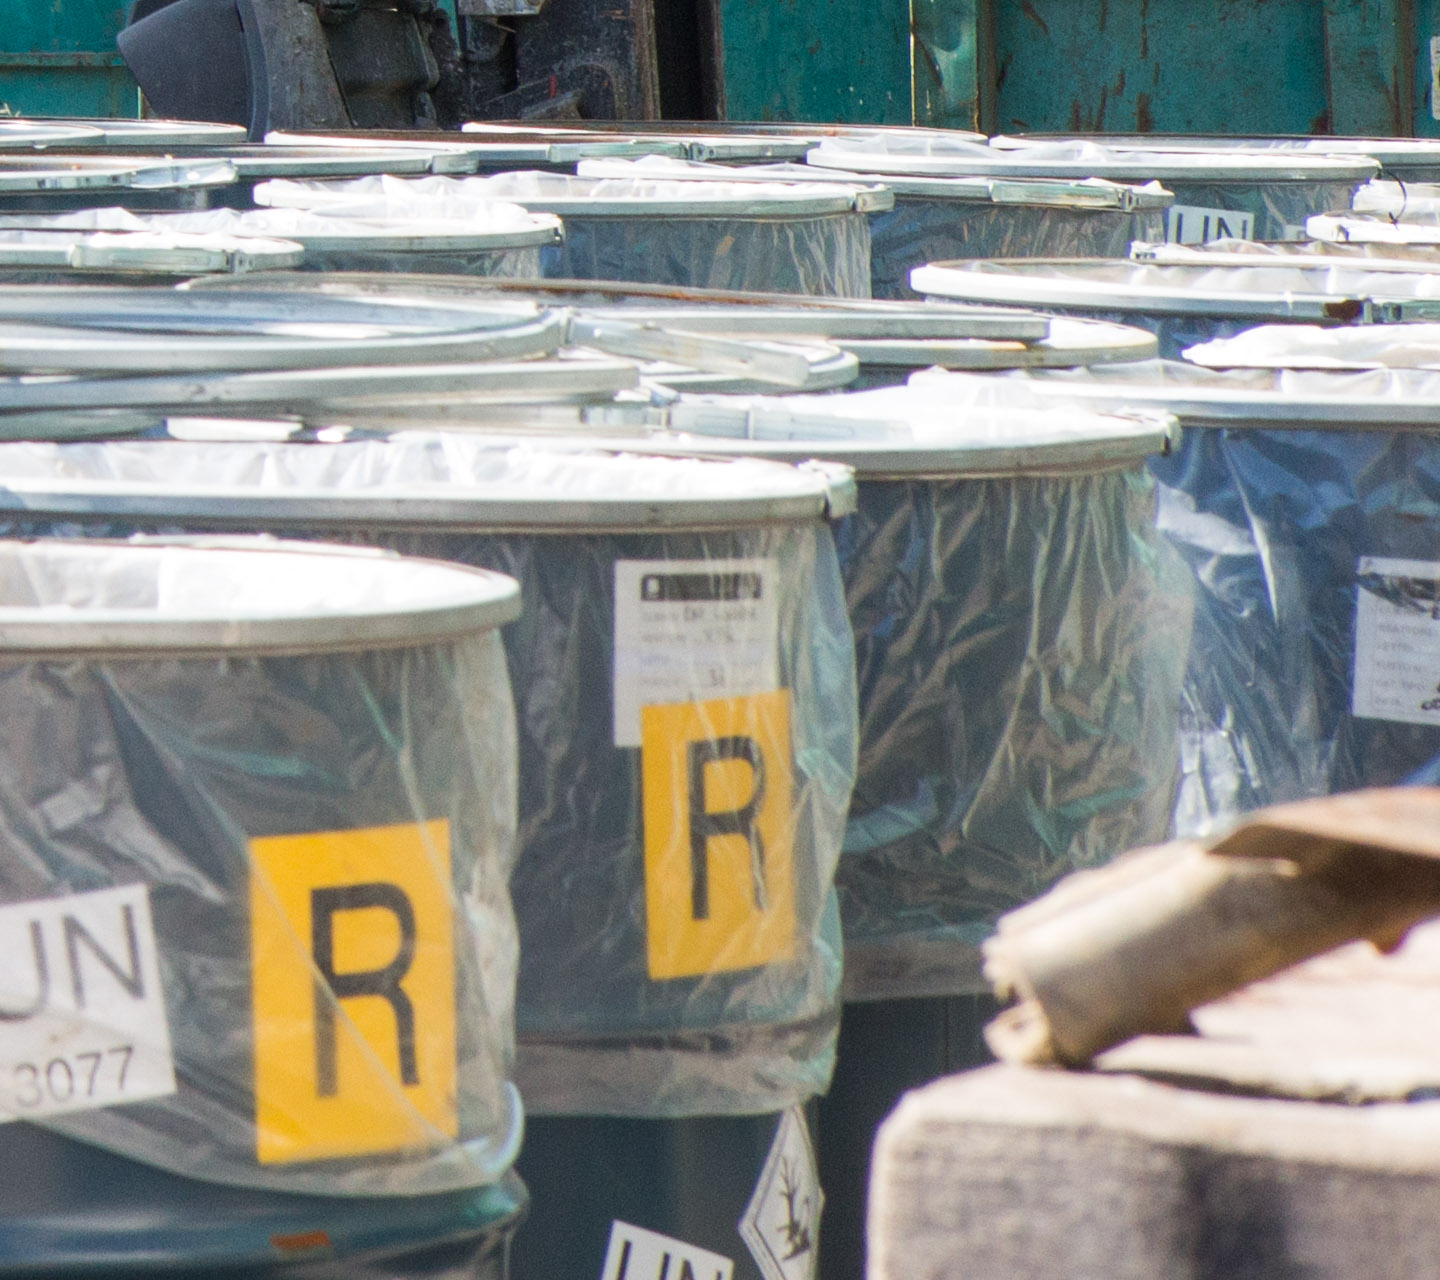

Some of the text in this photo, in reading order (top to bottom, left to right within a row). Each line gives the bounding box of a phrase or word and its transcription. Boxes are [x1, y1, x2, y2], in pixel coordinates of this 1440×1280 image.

[688, 735, 770, 921] R
[13, 1044, 135, 1108] 3077
[310, 881, 421, 1098] R
